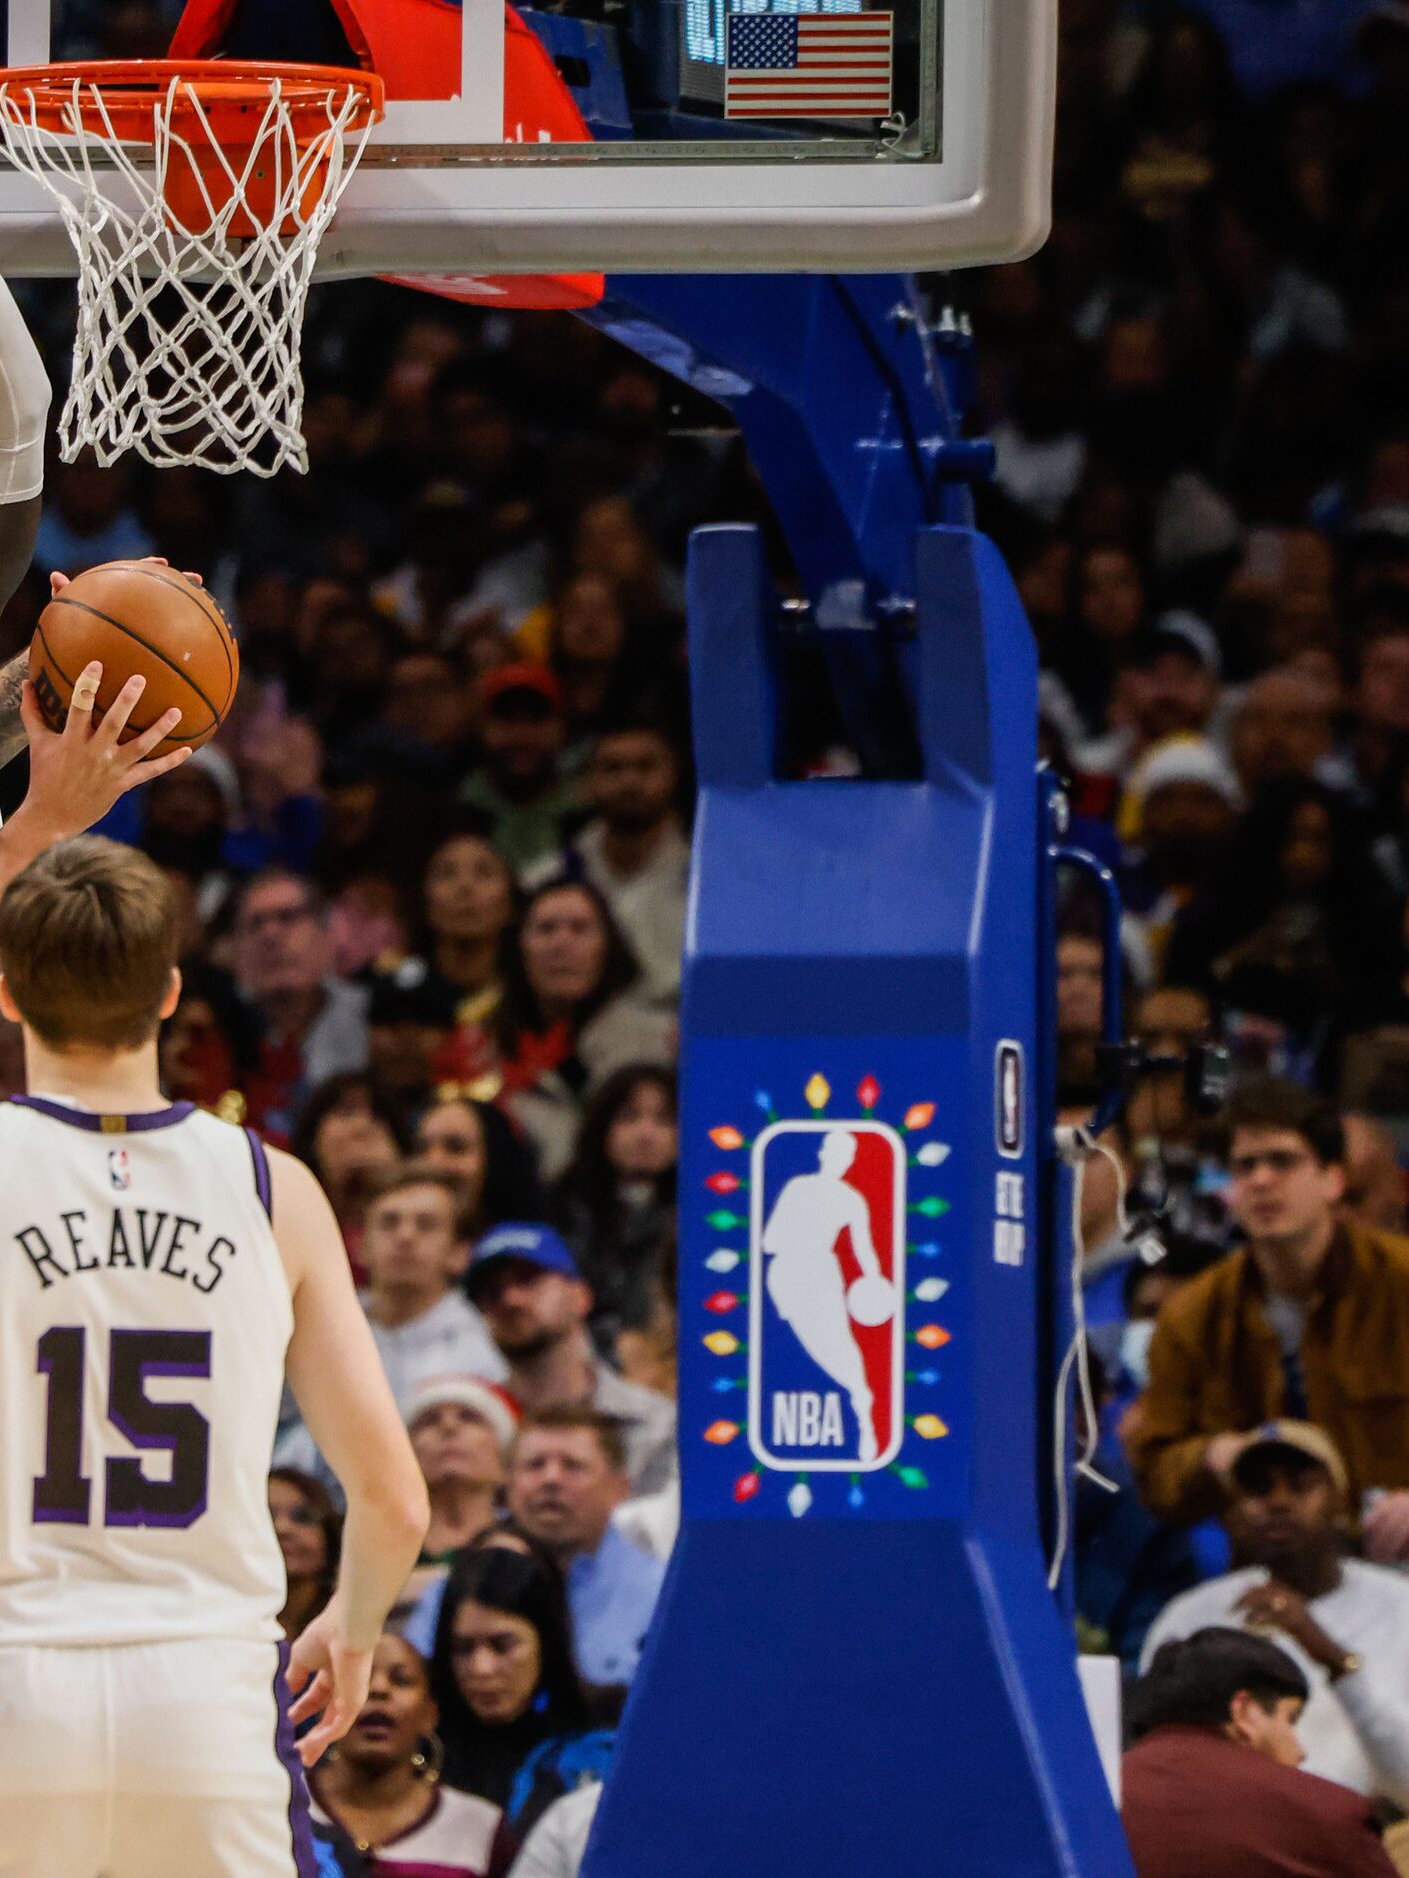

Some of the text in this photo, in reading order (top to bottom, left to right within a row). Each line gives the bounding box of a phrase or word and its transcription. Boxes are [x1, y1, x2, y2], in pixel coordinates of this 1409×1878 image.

[15, 1208, 236, 1293] REAVES
[32, 1326, 212, 1529] 15
[772, 1390, 845, 1447] NBA
